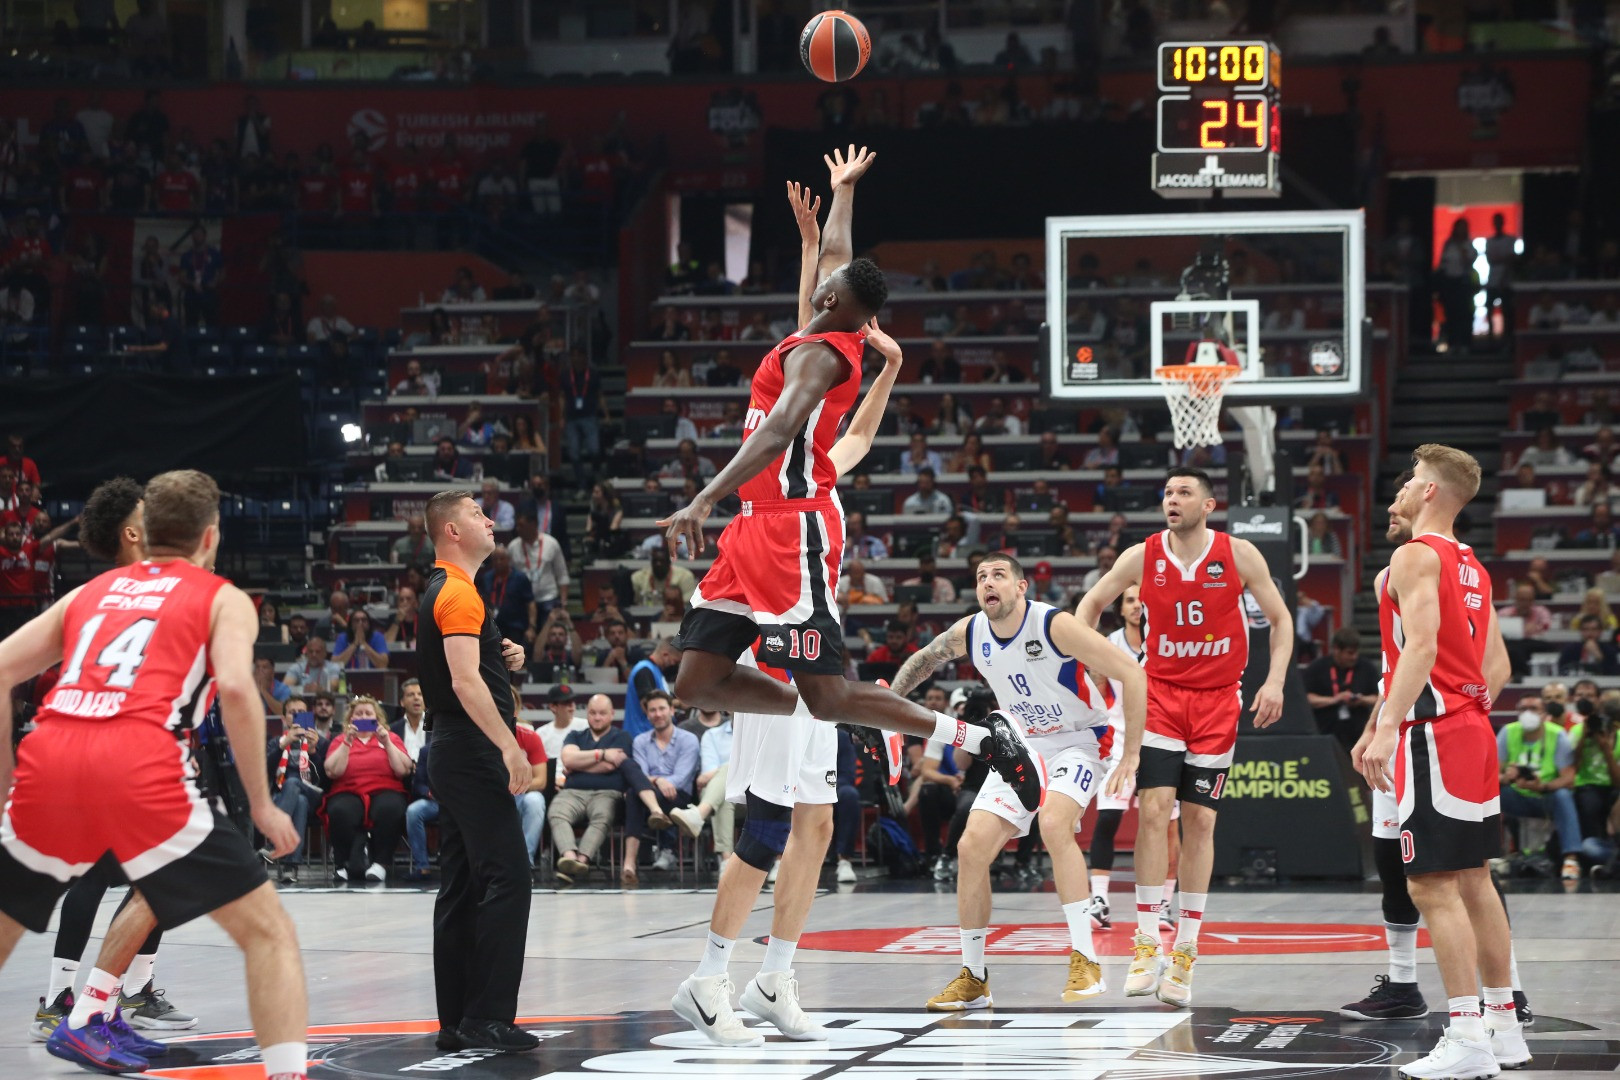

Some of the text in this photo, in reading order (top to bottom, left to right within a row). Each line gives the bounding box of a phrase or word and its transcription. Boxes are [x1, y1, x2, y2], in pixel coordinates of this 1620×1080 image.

[1173, 46, 1264, 81] 10:00
[396, 113, 469, 128] TURKISH
[1200, 100, 1265, 148] 24
[1159, 173, 1267, 187] JACQUES LEMANS
[98, 594, 166, 611] FMS
[1175, 600, 1204, 626] 16
[56, 613, 159, 689] 14
[788, 628, 821, 660] 10
[1158, 633, 1231, 658] bwin
[1008, 673, 1031, 696] 18
[1009, 701, 1063, 716] ANADOLU
[1022, 713, 1060, 727] EFES
[955, 723, 967, 744] GSA
[1073, 764, 1093, 792] 18
[1228, 760, 1298, 779] IMATE
[1221, 779, 1331, 799] AMPIONS
[1400, 829, 1415, 863] 0
